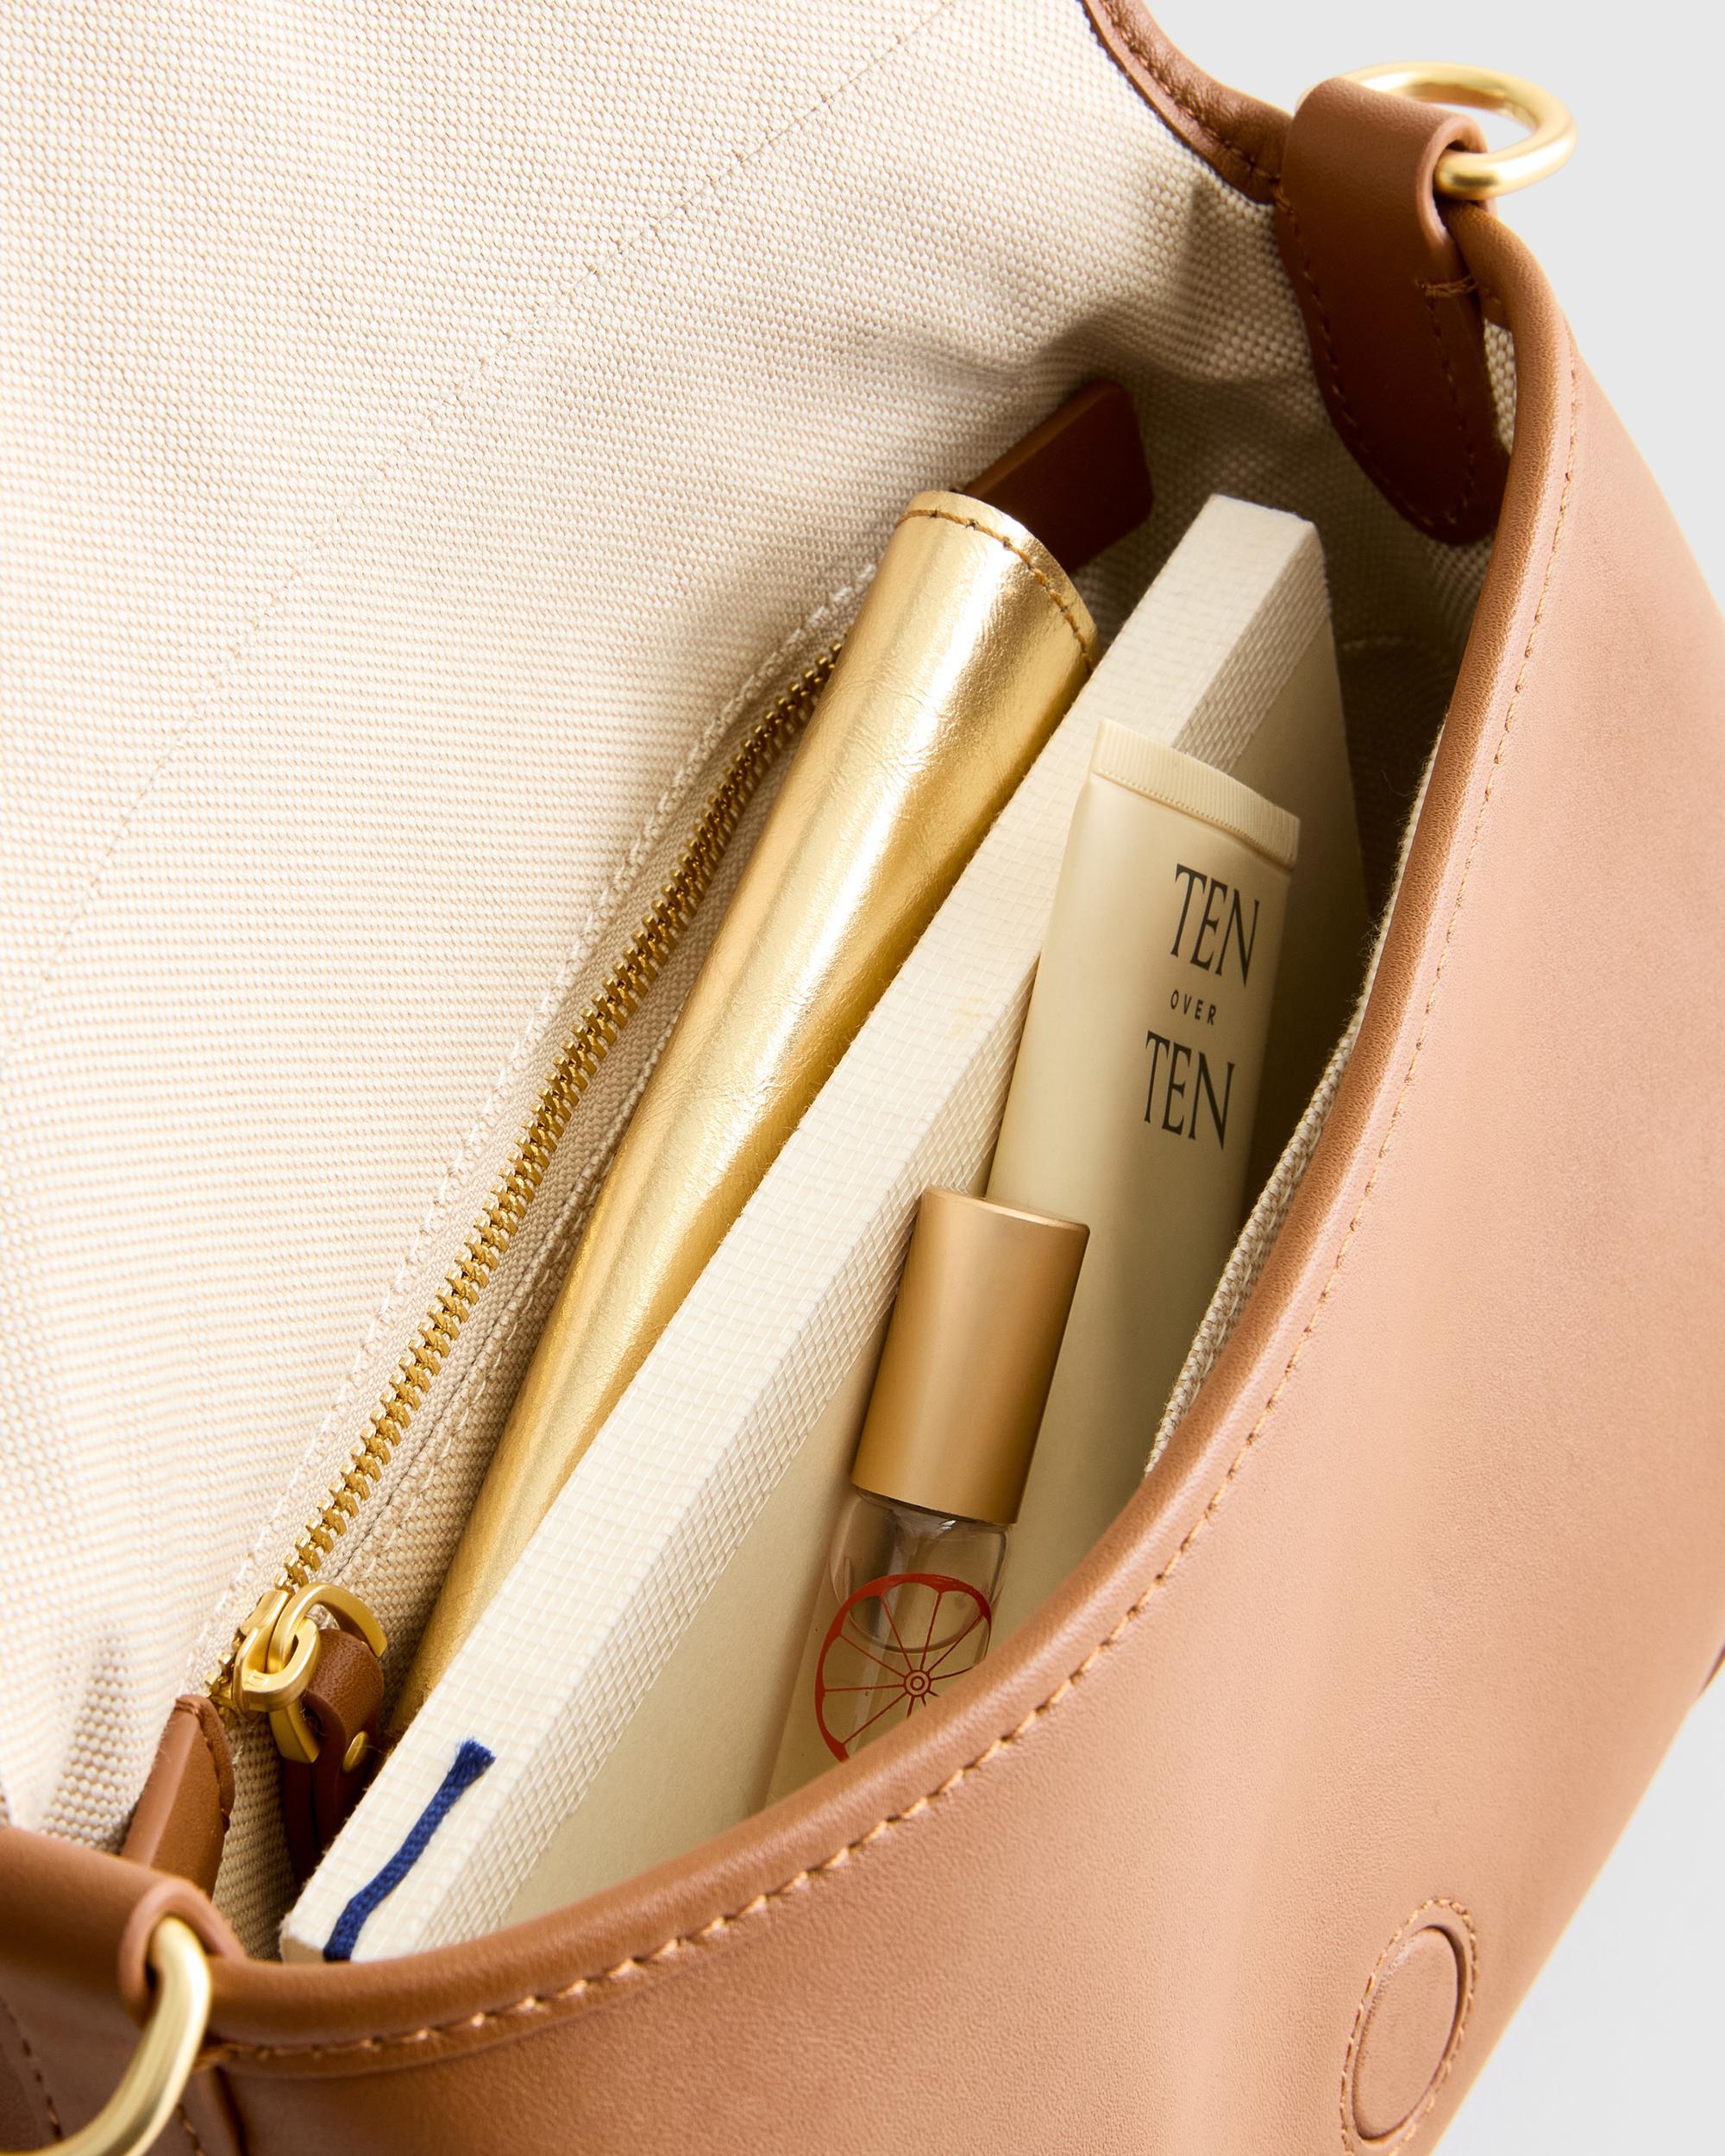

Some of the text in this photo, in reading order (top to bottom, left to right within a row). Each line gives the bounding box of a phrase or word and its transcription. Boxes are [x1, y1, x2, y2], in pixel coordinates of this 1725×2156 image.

[1170, 863, 1259, 987] TEN
[1170, 989, 1217, 1025] OVER
[1144, 1030, 1235, 1150] TEN
